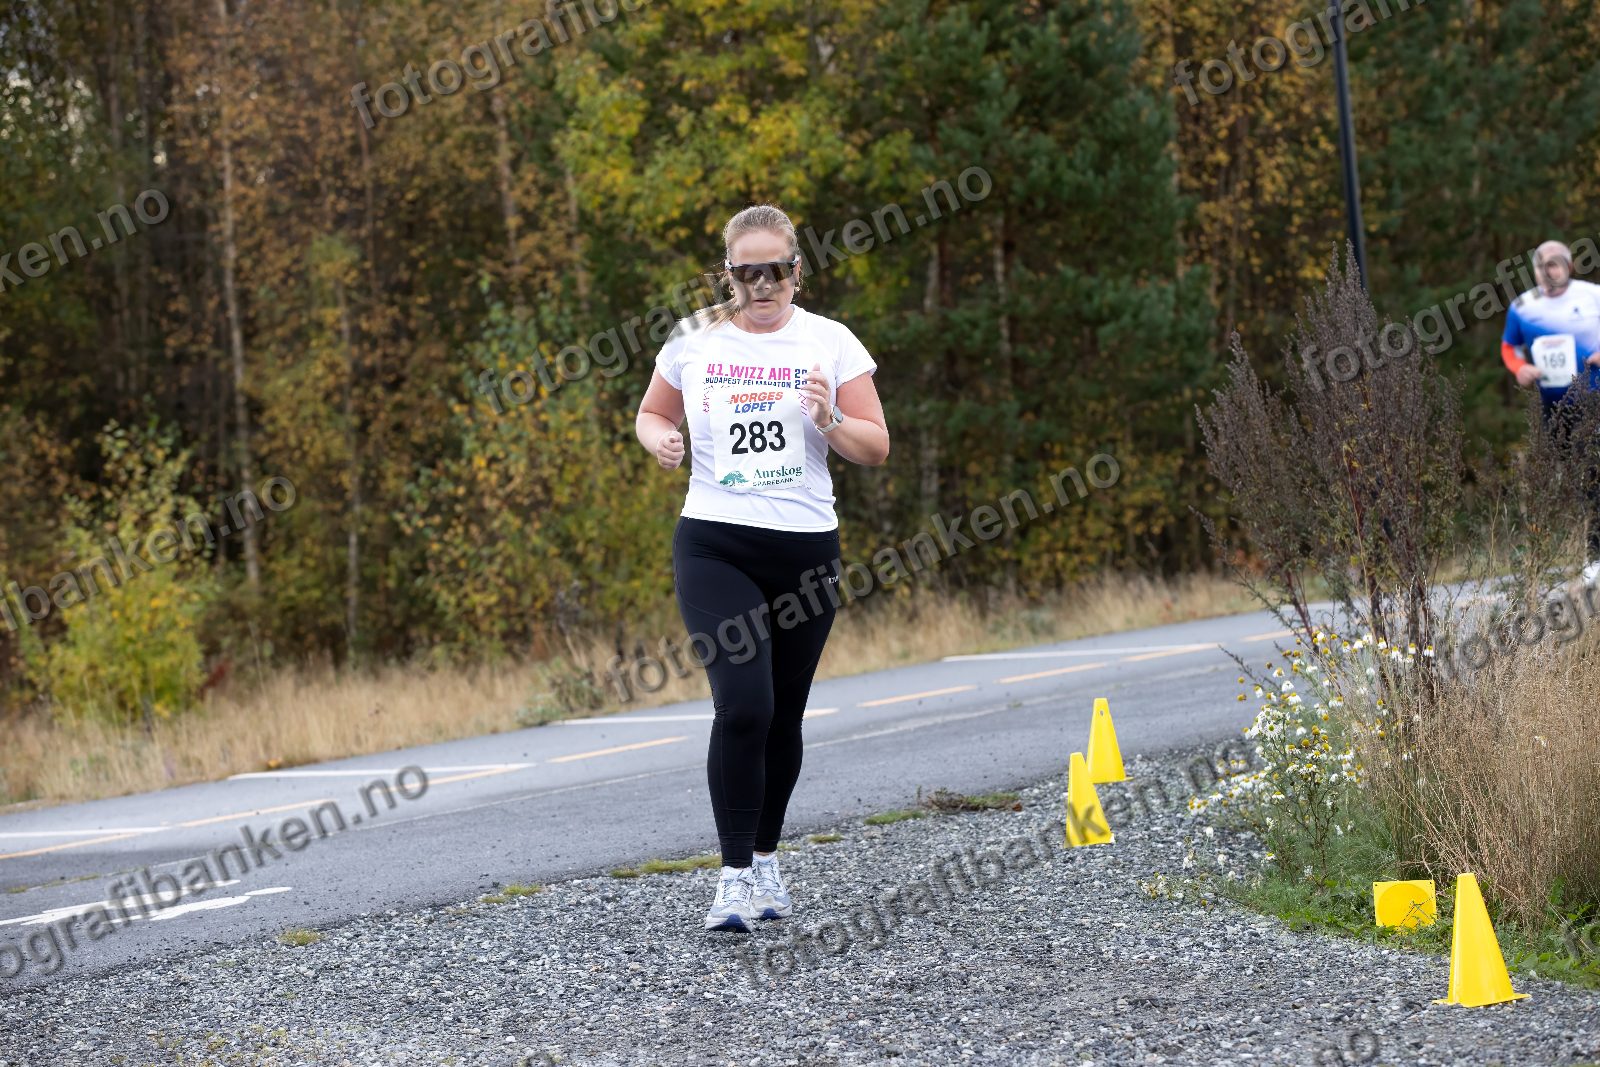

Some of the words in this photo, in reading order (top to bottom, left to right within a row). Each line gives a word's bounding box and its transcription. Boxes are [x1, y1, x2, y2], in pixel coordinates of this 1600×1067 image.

[1543, 352, 1566, 369] 169
[768, 367, 791, 381] AIR
[705, 377, 741, 385] BUDAPEST
[729, 391, 784, 405] NORGES
[734, 401, 776, 414] LØPET
[729, 420, 786, 455] 283
[753, 465, 803, 478] Aurskog
[752, 477, 794, 487] SPAREBANK
